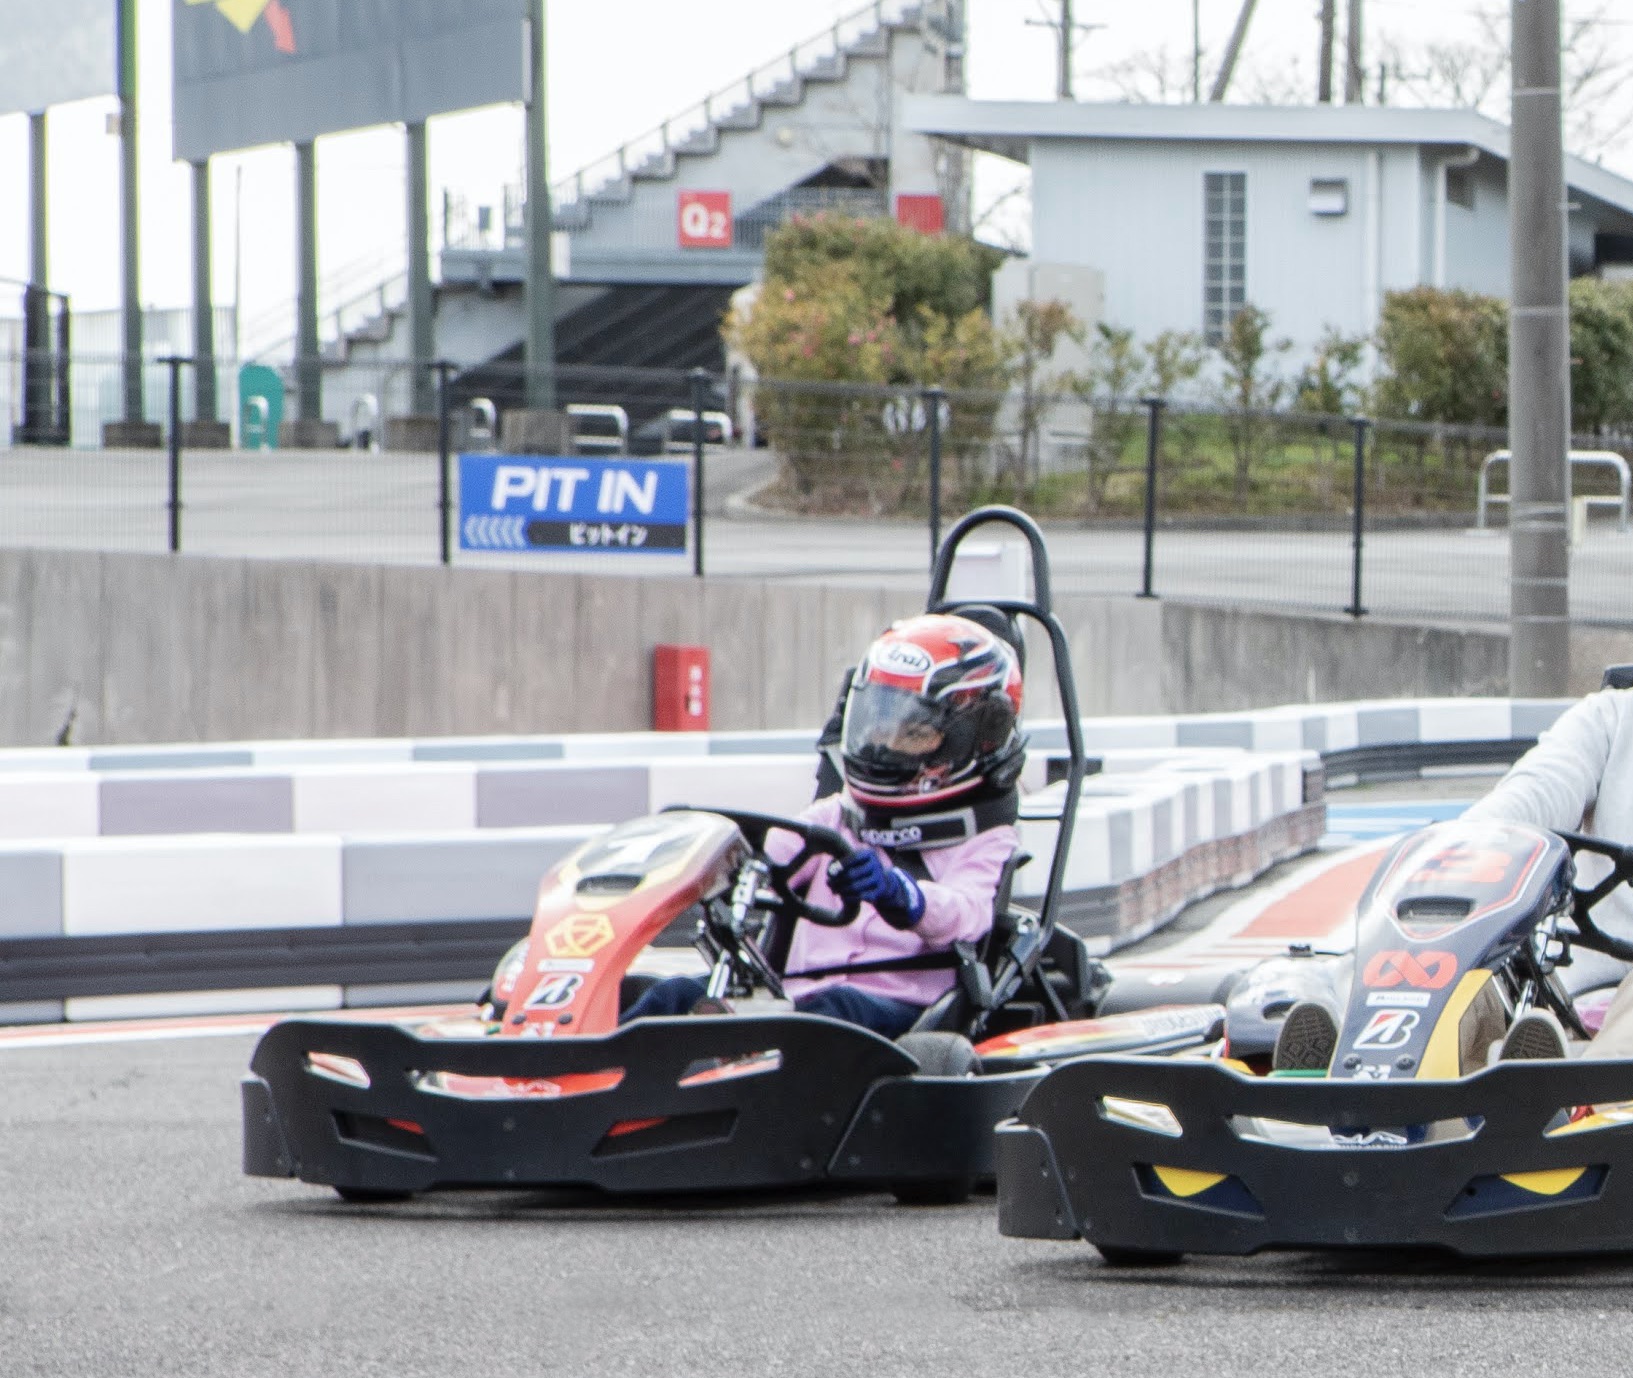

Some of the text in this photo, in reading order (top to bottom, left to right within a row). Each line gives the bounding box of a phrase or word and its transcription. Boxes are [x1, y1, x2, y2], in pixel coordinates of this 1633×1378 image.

[681, 202, 727, 239] Q2
[491, 466, 658, 515] PIT IN
[568, 521, 648, 547] ピットイン
